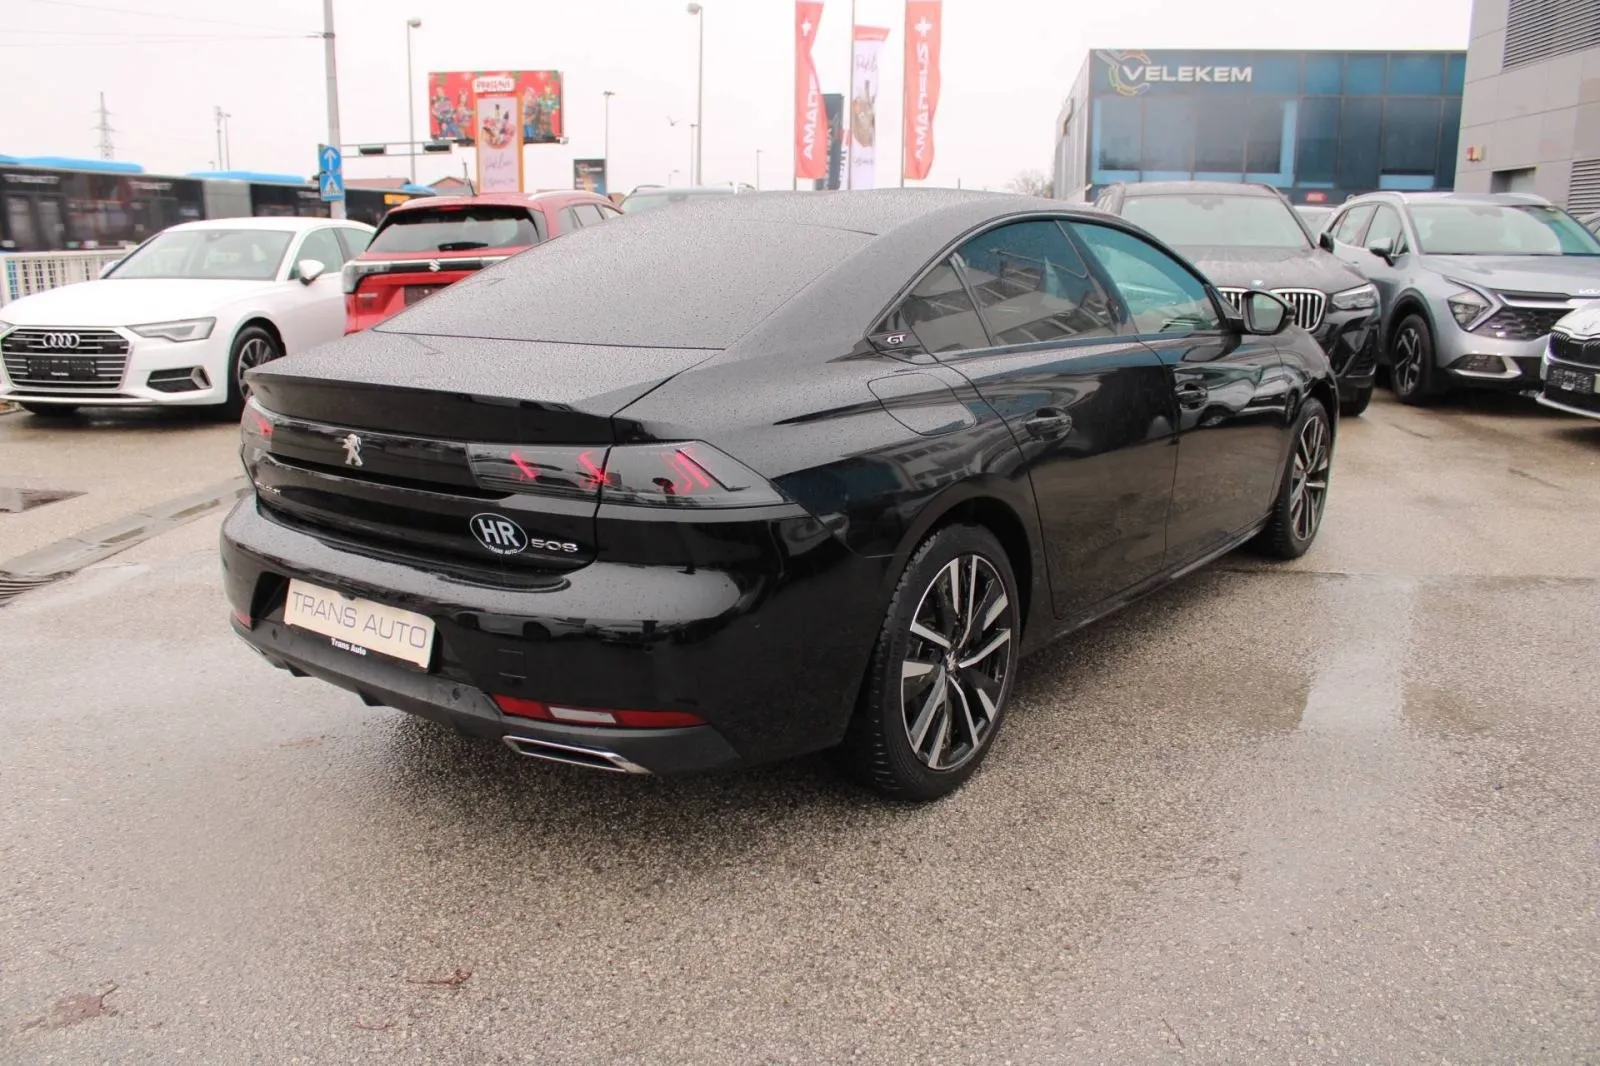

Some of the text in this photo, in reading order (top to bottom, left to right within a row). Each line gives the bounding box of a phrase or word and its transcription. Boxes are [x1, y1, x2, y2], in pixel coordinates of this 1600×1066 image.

[1122, 64, 1253, 83] VELEKEM
[887, 334, 906, 345] GT
[478, 518, 521, 547] HR
[488, 545, 518, 556] TRANS AUTO
[531, 538, 579, 553] 508
[293, 591, 427, 649] TRANS AUTO
[331, 637, 367, 656] Trans Auto
